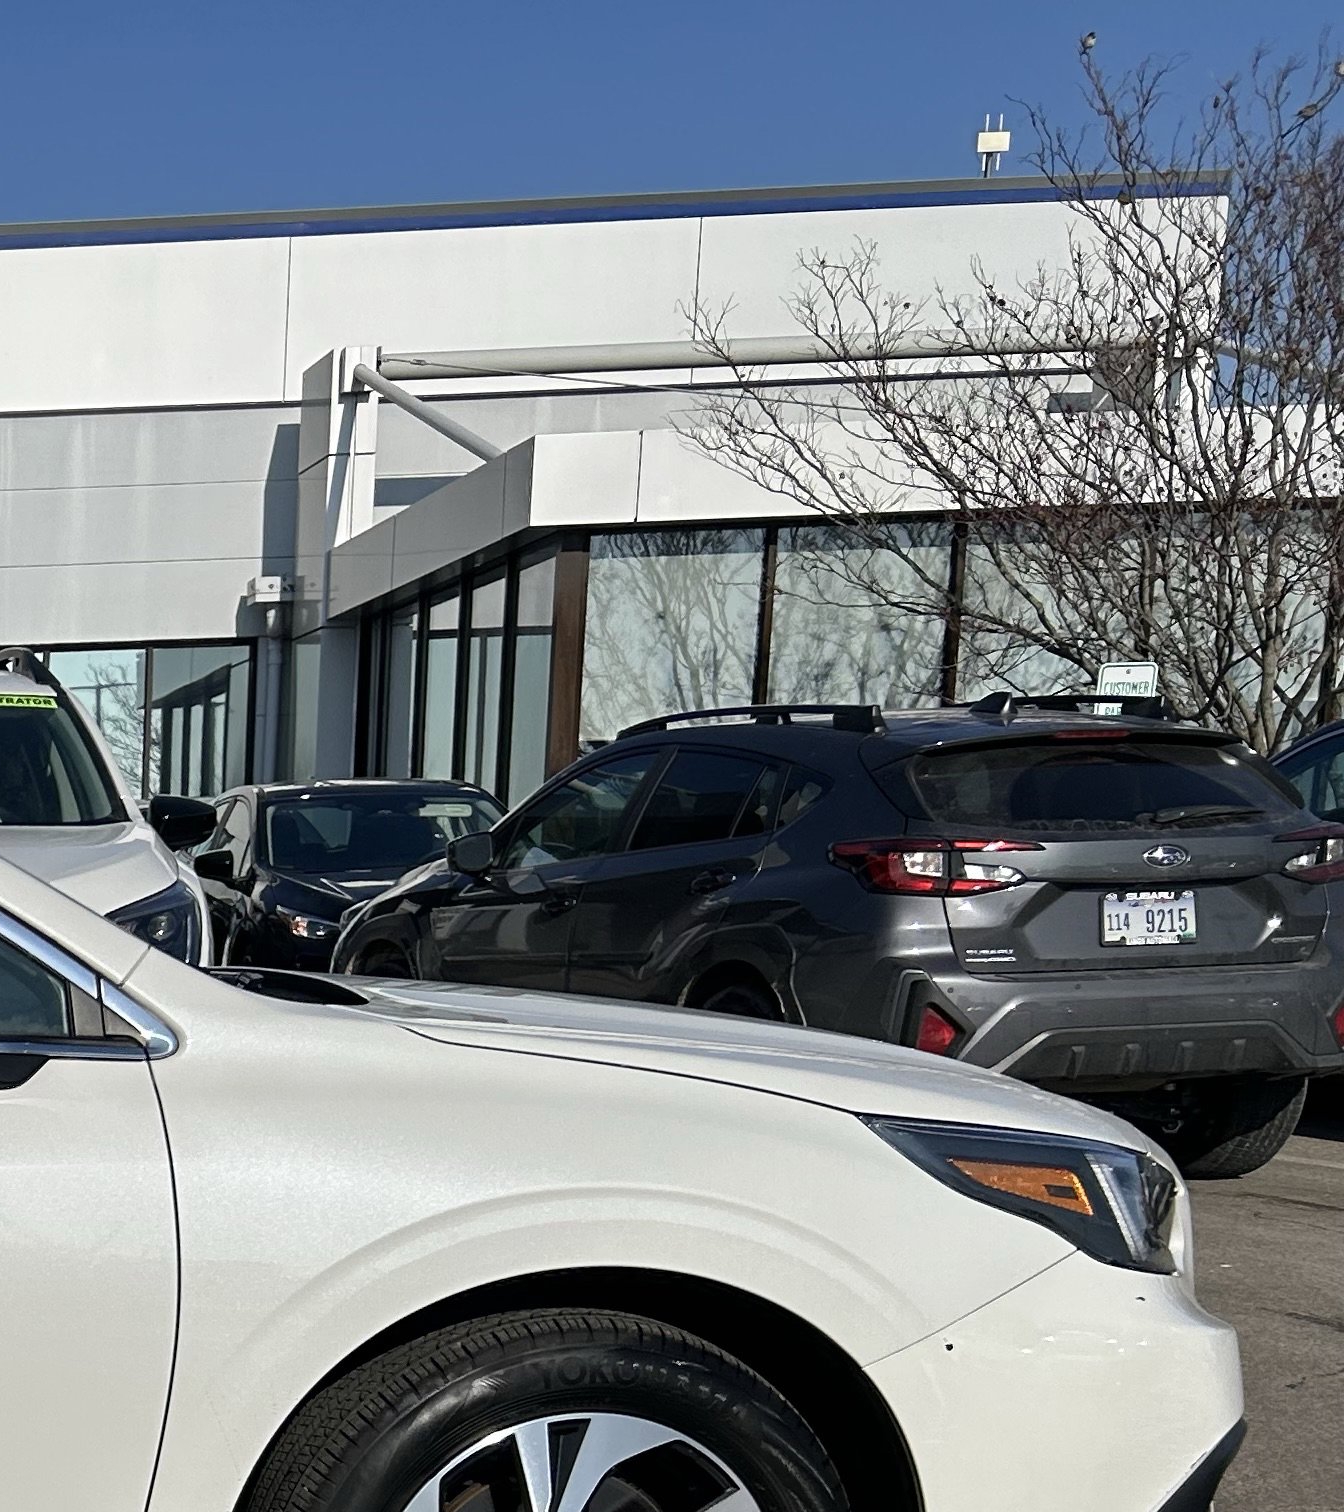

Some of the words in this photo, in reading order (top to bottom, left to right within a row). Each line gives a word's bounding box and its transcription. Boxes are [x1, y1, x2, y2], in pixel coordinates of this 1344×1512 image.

[1104, 681, 1150, 695] CUSTOMER
[1125, 891, 1175, 901] SUBARU
[1106, 912, 1130, 932] 114
[1145, 907, 1188, 933] 9215
